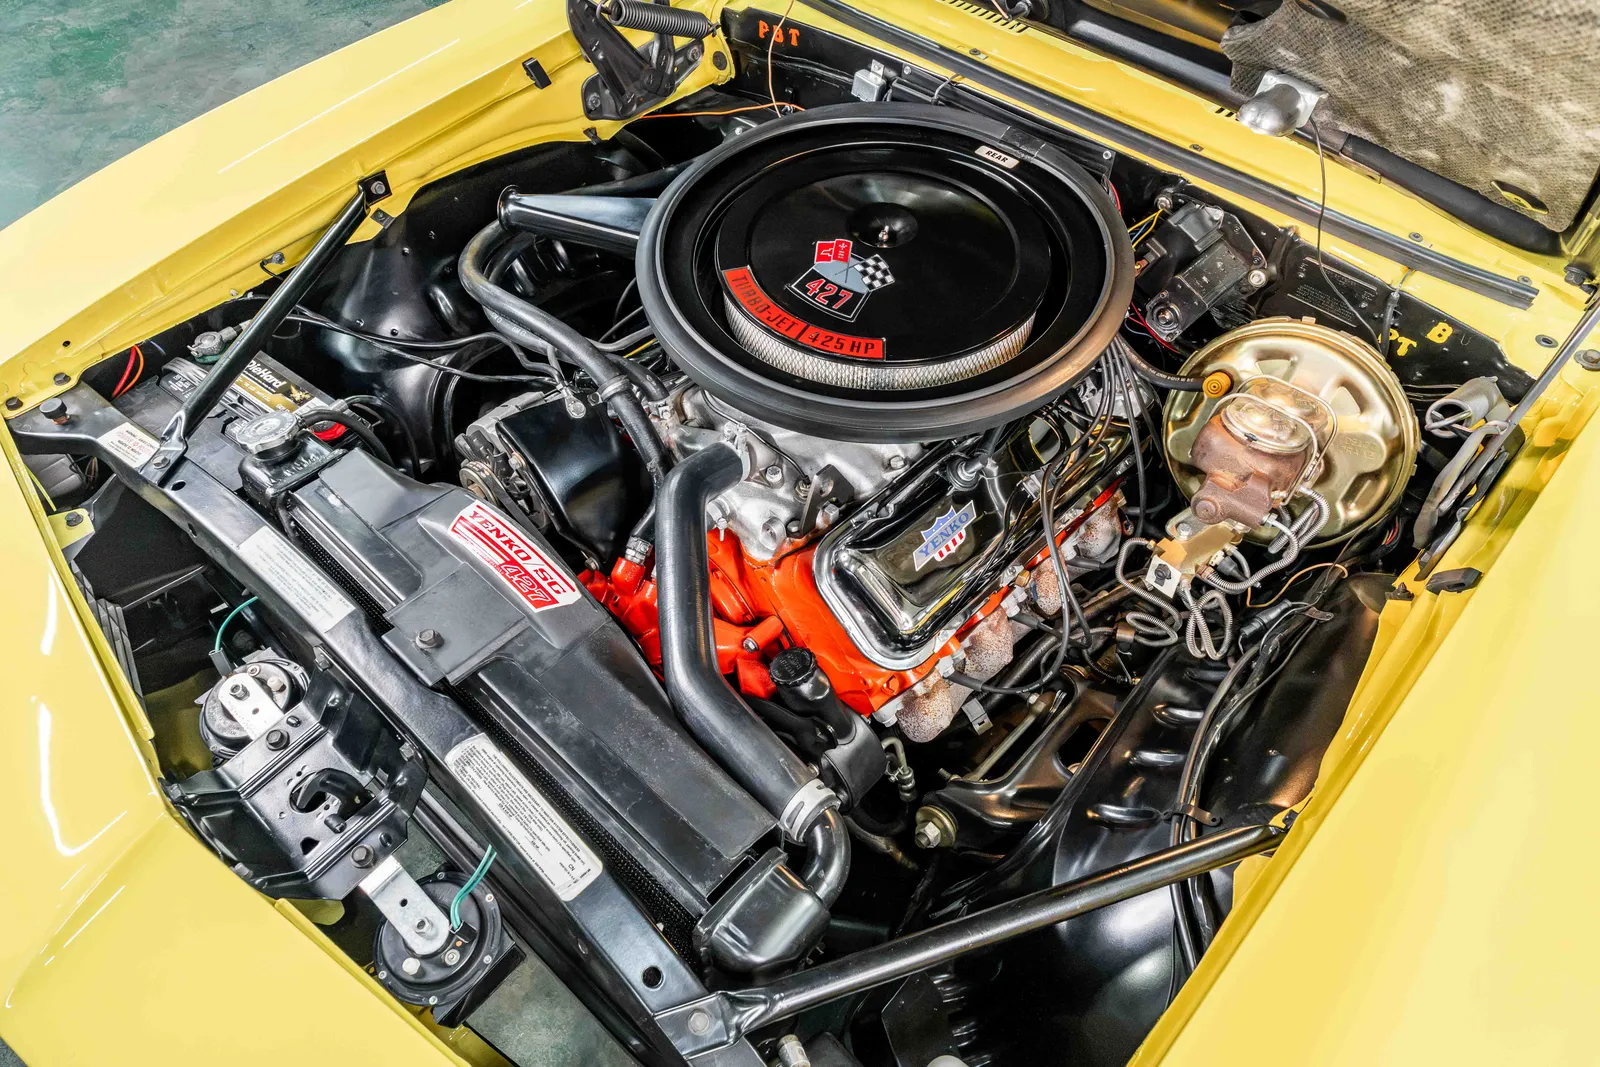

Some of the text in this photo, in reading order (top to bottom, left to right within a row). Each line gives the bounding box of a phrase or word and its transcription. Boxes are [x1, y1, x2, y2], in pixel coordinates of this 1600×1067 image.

[985, 150, 1009, 163] REAR
[805, 278, 854, 310] 427
[731, 274, 875, 354] TURBO-JET 425 HP
[918, 511, 970, 558] YENKO
[500, 564, 551, 603] 427
[567, 862, 576, 872] CN
